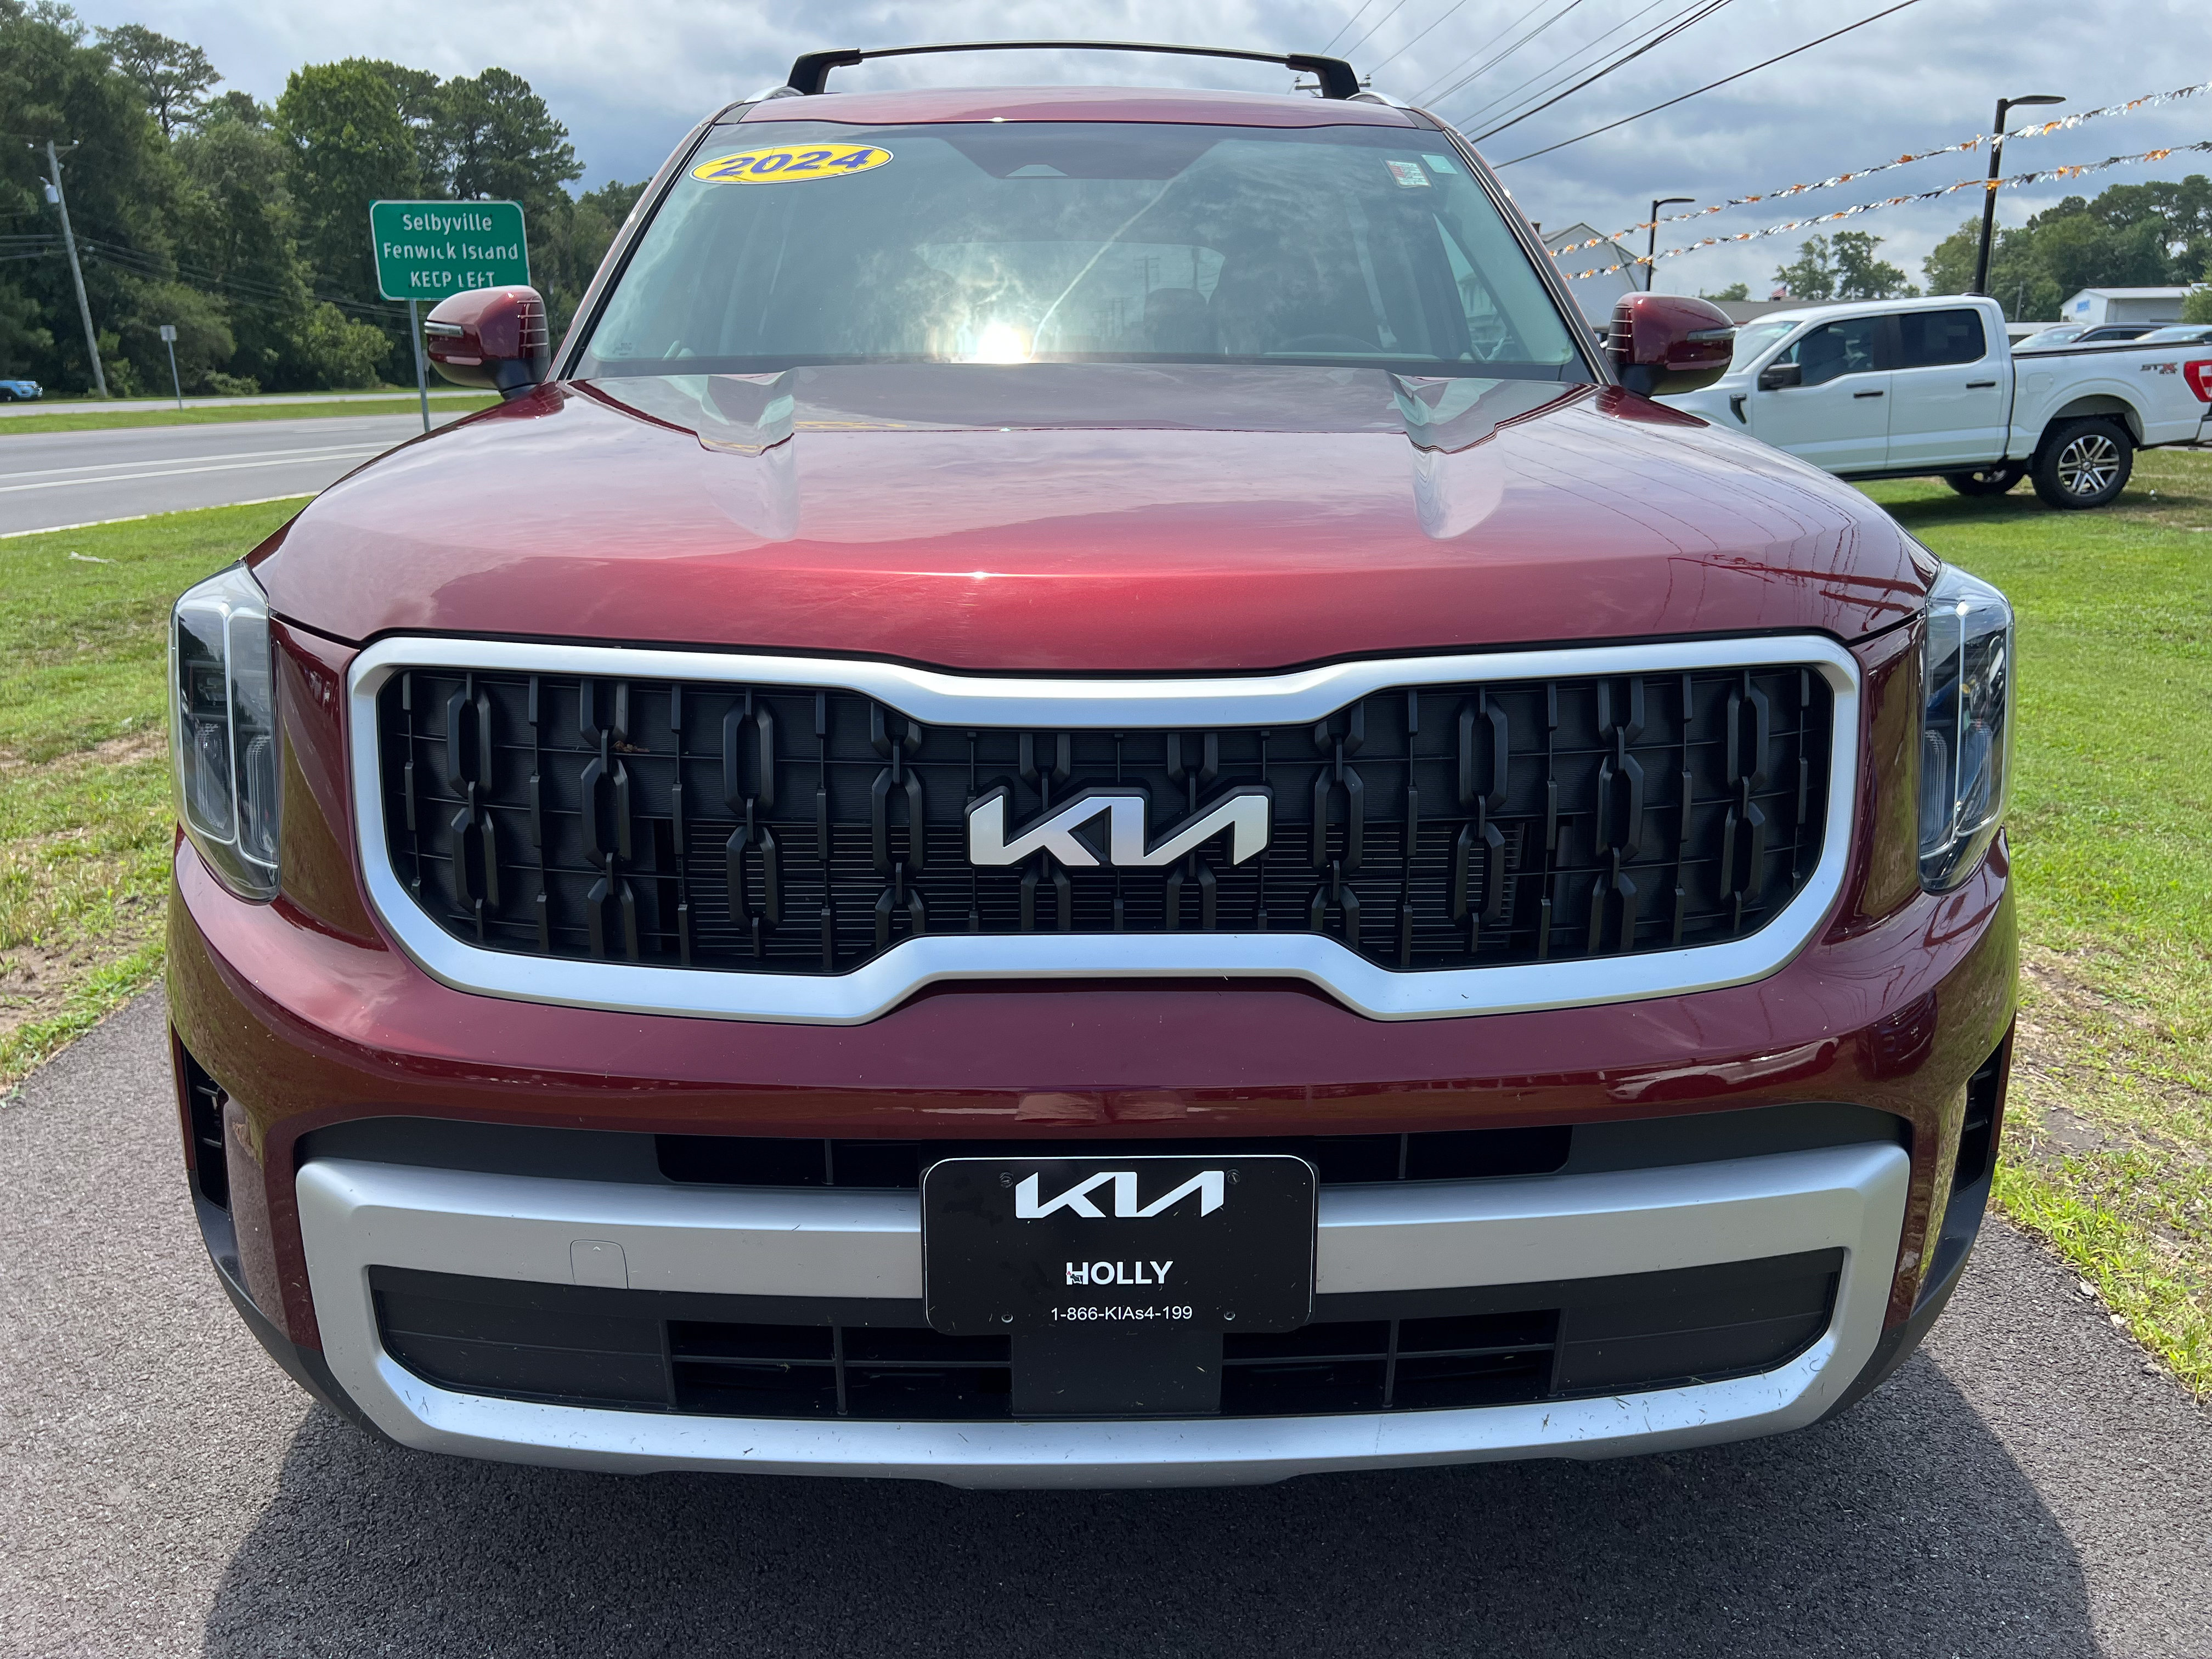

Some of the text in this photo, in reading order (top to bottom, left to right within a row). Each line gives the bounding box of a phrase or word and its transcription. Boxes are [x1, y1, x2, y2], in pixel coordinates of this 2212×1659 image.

[706, 148, 876, 178] 2024
[402, 212, 492, 235] Selbyville
[383, 242, 518, 260] Fenwick Island
[458, 271, 495, 288] LEFT
[969, 795, 1268, 866] KIA
[1015, 1170, 1224, 1218] KIA
[1066, 1261, 1173, 1285] HOLLY
[1051, 1306, 1193, 1321] 1-866-KIAs4-199
